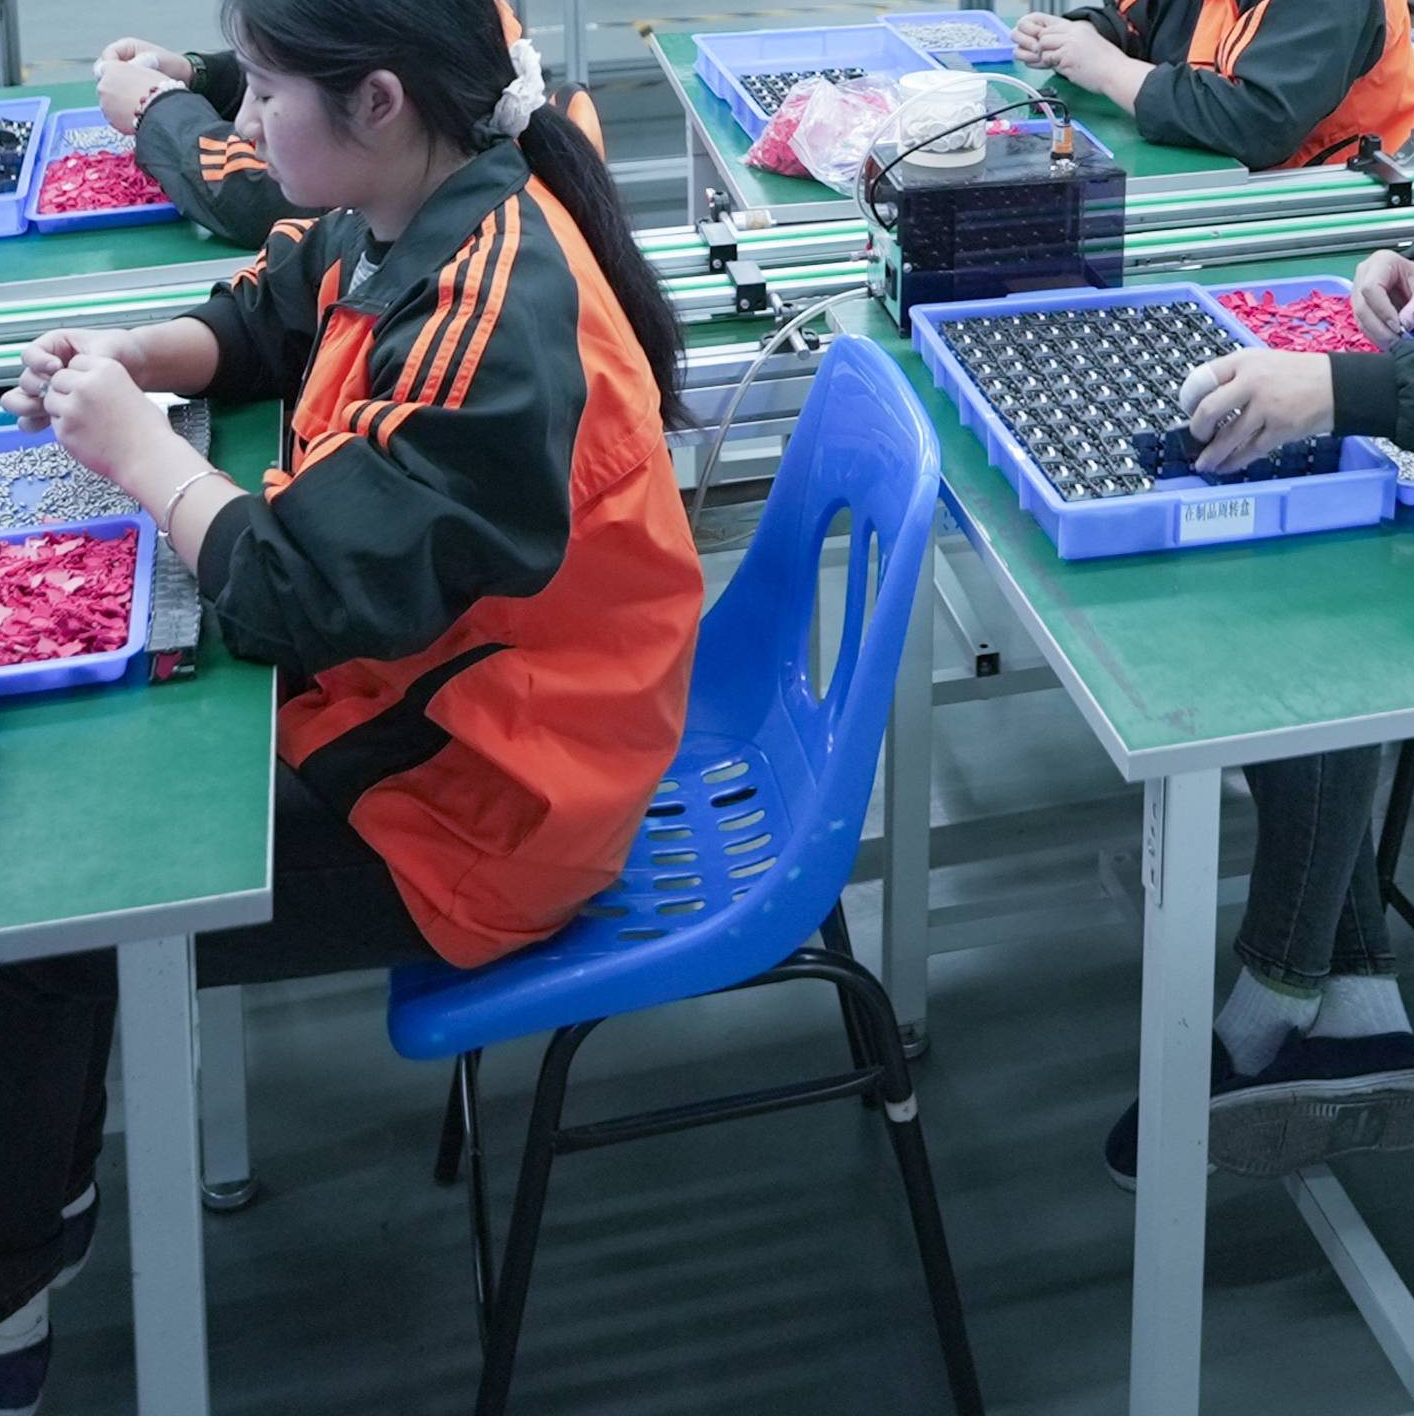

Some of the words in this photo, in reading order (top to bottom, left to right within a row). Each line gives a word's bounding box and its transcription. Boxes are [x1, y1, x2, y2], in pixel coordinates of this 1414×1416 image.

[1185, 498, 1250, 522] 在制品周转盒
